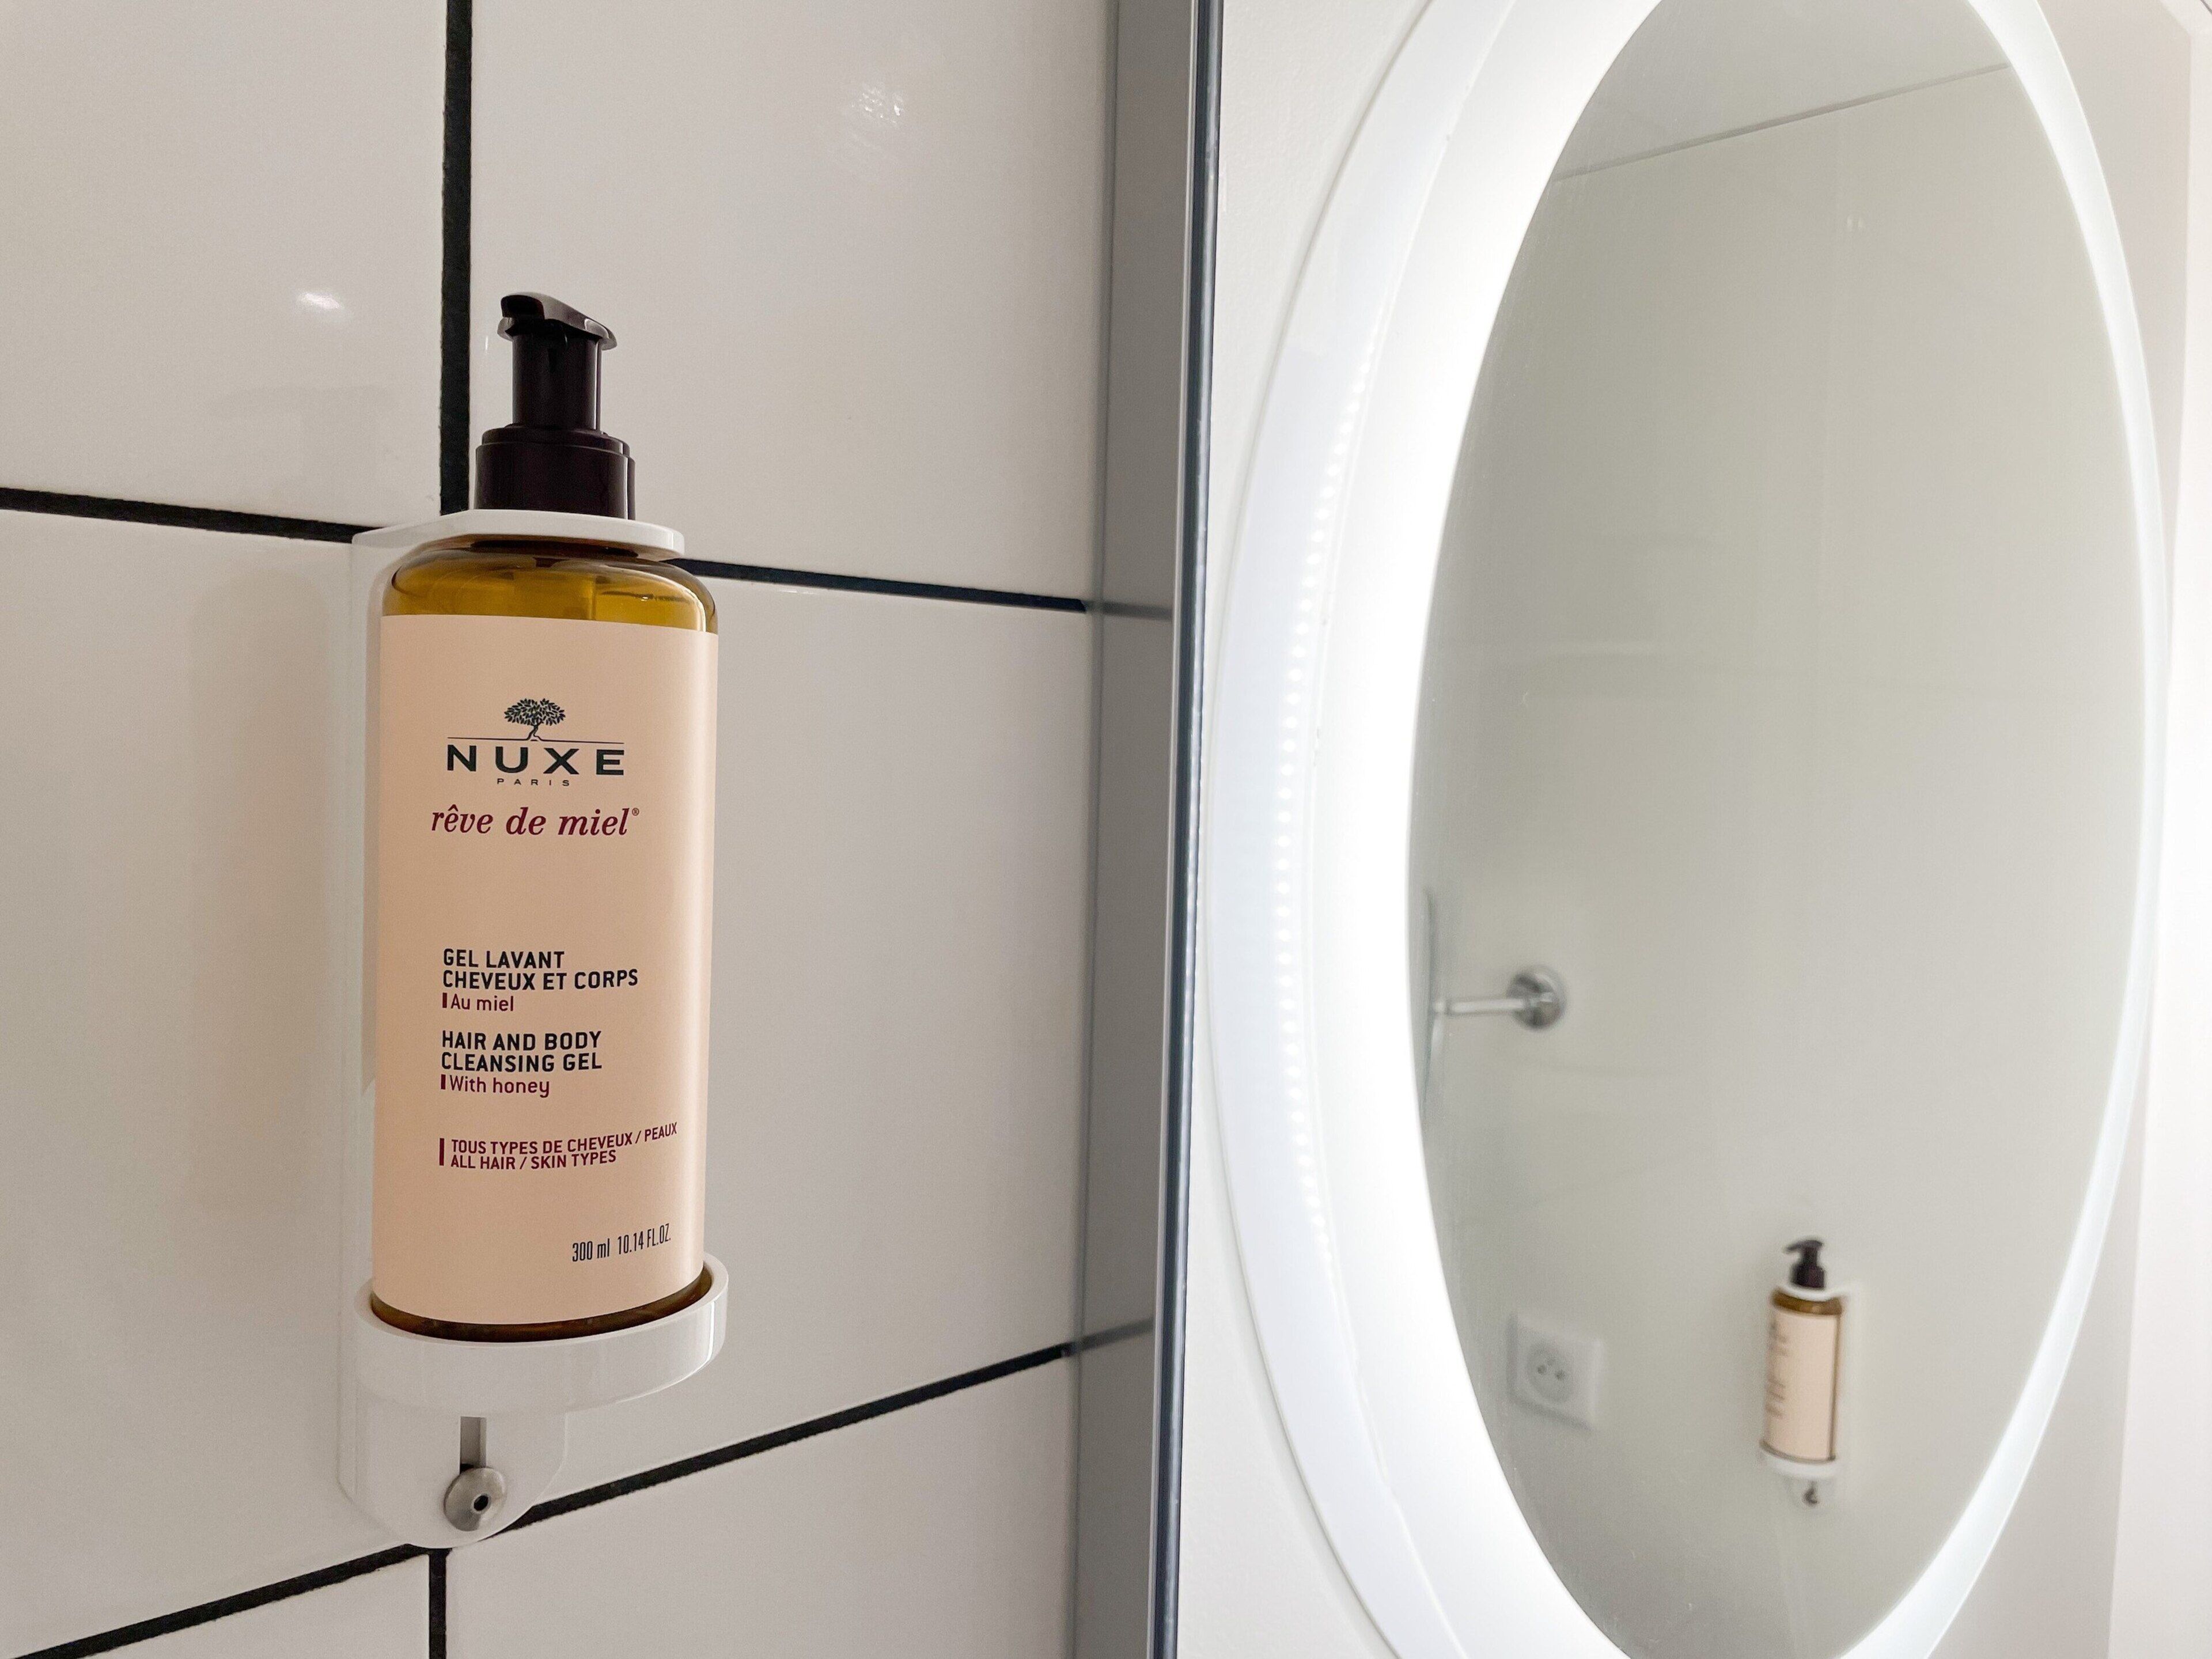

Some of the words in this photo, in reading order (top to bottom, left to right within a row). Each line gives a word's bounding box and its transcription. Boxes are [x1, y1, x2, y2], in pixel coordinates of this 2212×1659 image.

[446, 744, 625, 776] NUXE
[497, 778, 570, 787] PARIS
[431, 804, 494, 834] rêve
[505, 806, 547, 836] de
[443, 948, 479, 968] GEL
[486, 950, 565, 969] LAVANT
[442, 969, 536, 991] CHEVEUX
[543, 972, 567, 990] ET
[574, 968, 638, 990] CORPS
[450, 993, 471, 1010] Au
[476, 995, 514, 1012] miel
[442, 1029, 487, 1051] HAIR
[491, 1033, 536, 1051] AND
[544, 1030, 602, 1051] BODY
[441, 1051, 555, 1073] CLEANSING
[562, 1051, 603, 1071] GEL
[449, 1074, 487, 1093] With
[493, 1077, 550, 1099] honey
[451, 1138, 487, 1154] TOUS
[490, 1141, 538, 1155] TYPES
[542, 1139, 563, 1154] DE
[567, 1131, 633, 1153] CHEVEUX
[644, 1121, 677, 1143] PEAUX
[450, 1154, 476, 1169] ALL
[480, 1156, 516, 1170] HAIR
[531, 1154, 567, 1170] SKIN
[571, 1149, 616, 1167] TYPES
[571, 1240, 593, 1262] 300
[596, 1237, 611, 1259] ml
[617, 1230, 645, 1255] 10.14
